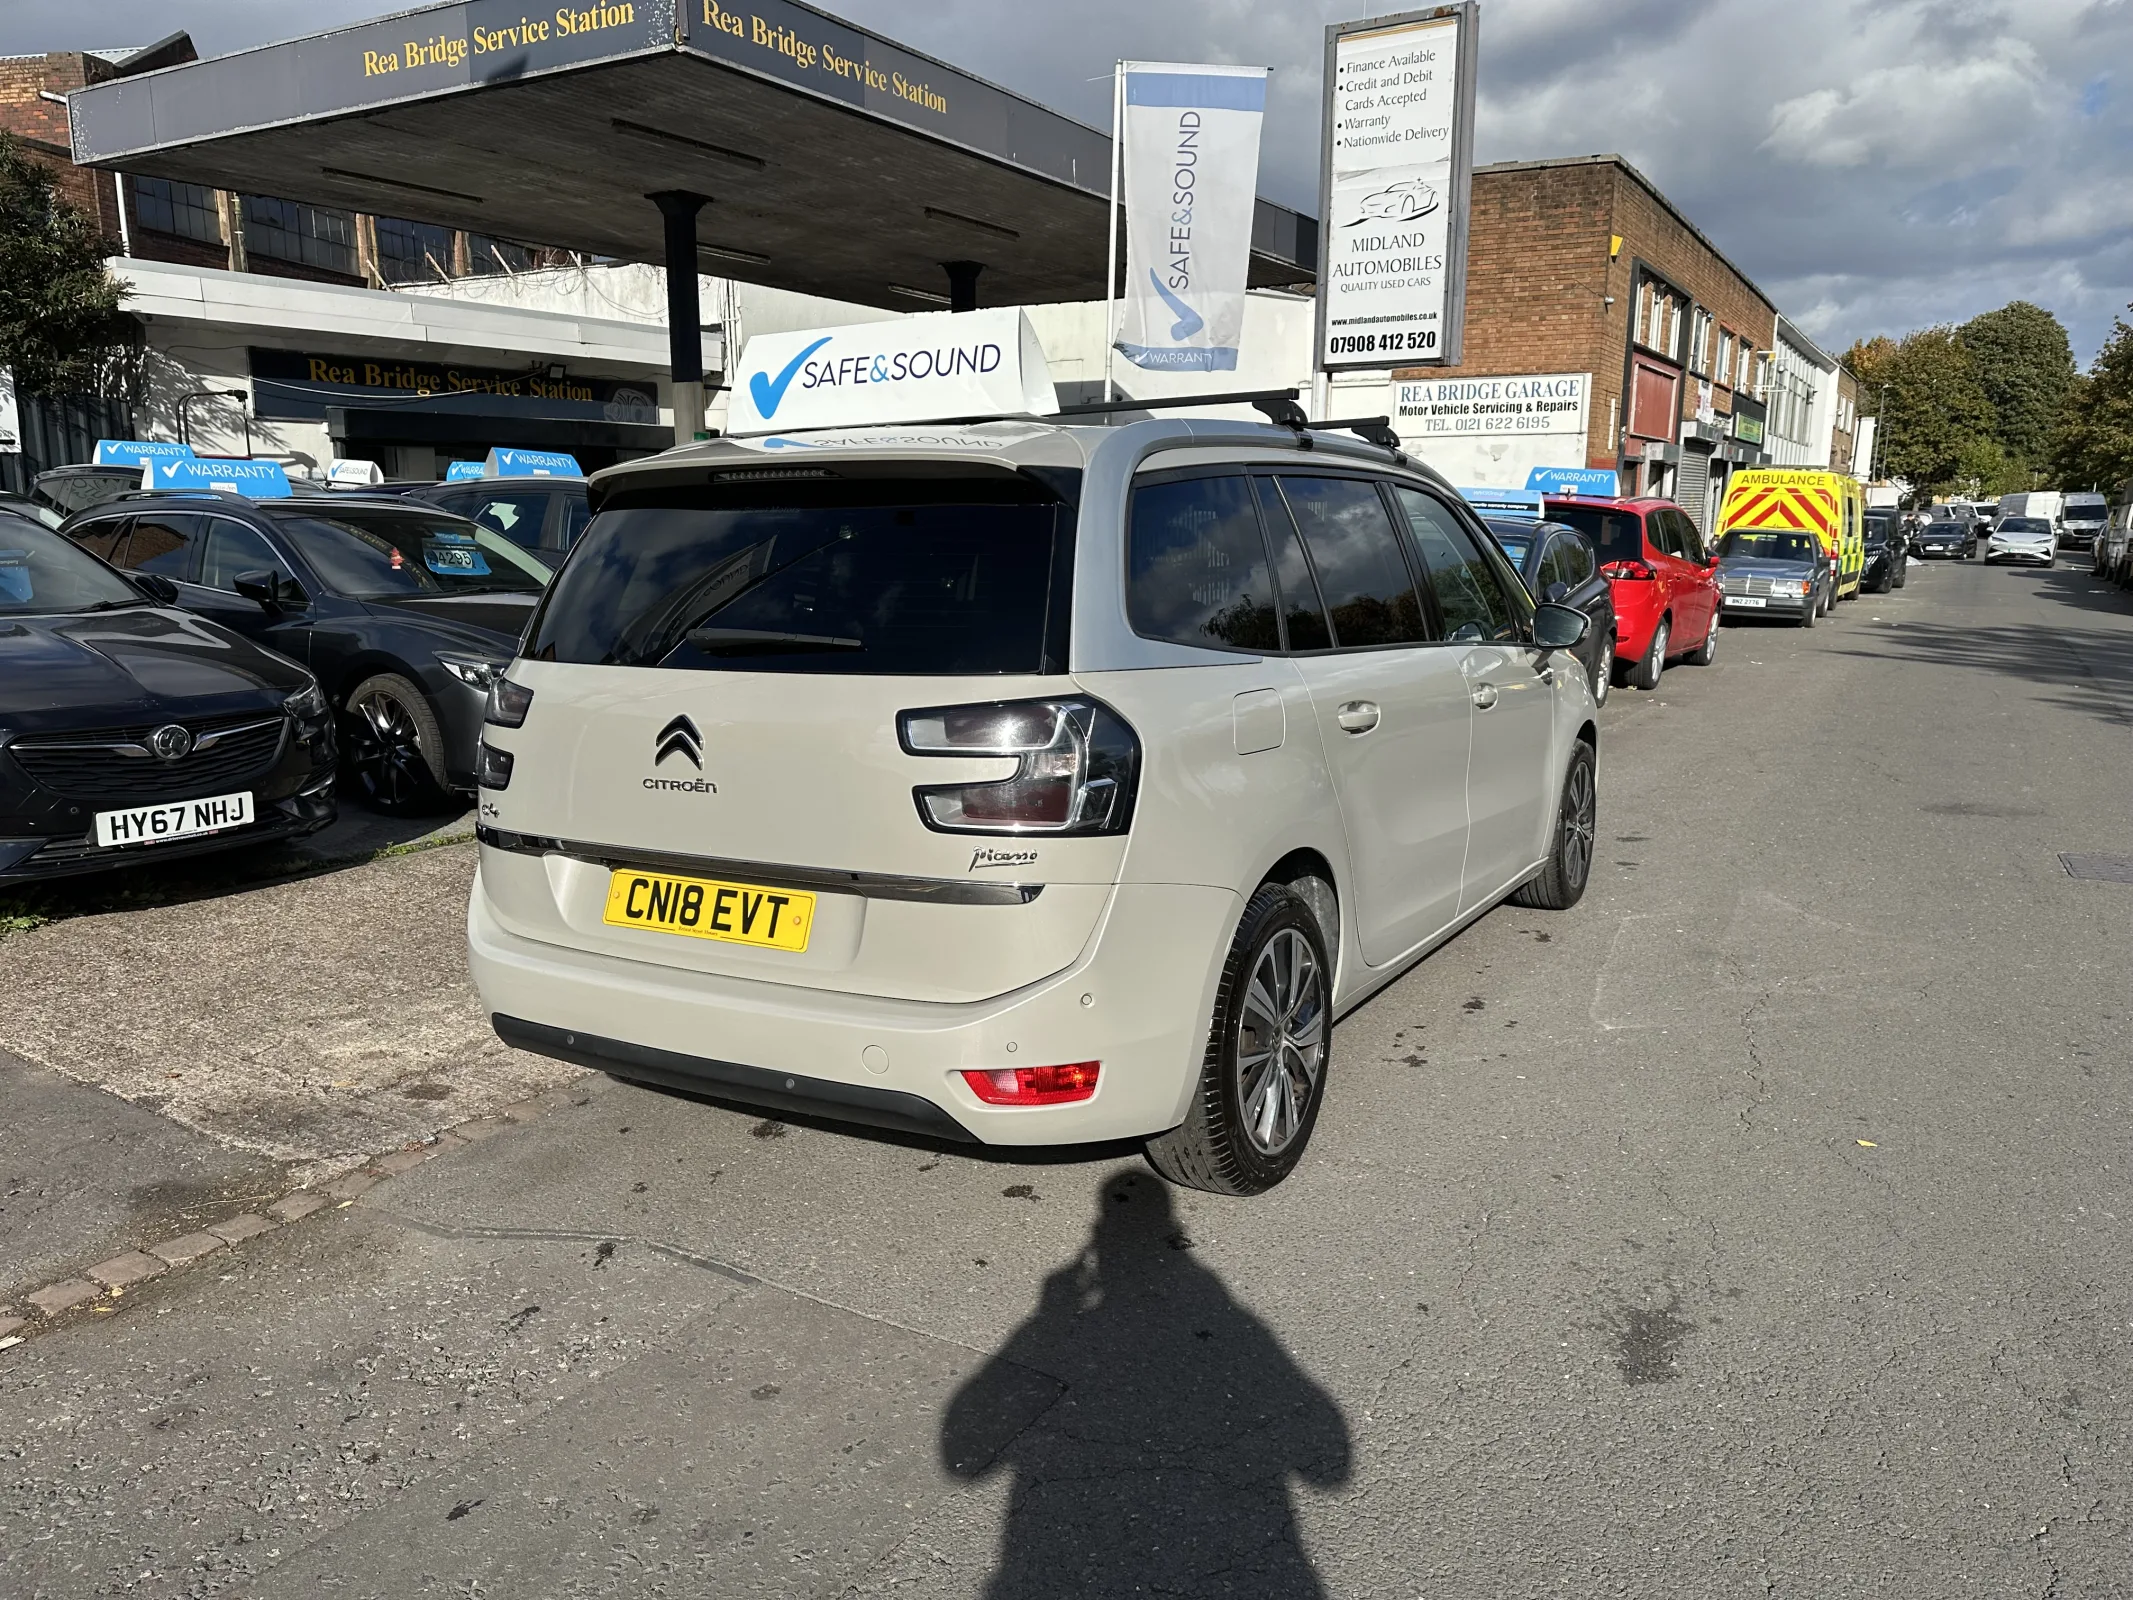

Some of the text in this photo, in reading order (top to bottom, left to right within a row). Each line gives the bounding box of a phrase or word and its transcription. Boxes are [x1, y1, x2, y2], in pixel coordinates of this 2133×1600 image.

[363, 1, 635, 77] Rea Bridge Service Station
[701, 0, 947, 114] Rea Bridge Service Station
[1346, 49, 1436, 74] Finance Available
[1345, 69, 1433, 92] Credit and Debit
[1345, 88, 1427, 111] Cards Accepted
[1344, 115, 1391, 130] Warranty
[1343, 126, 1450, 149] Nationwide Delivery
[1169, 111, 1201, 290] SAFE&SOUND
[1351, 232, 1425, 253] MIDLAND
[1332, 254, 1442, 278] AUTOMOBILES
[1340, 276, 1432, 293] QUALITY USED CARS
[1331, 311, 1438, 327] www.midlandautomobiles.co.uk
[1330, 330, 1437, 354] 07908 412 520
[802, 343, 1002, 389] SAFE&SOUND
[1149, 351, 1213, 364] WARRANTY
[308, 358, 594, 402] Rea Bridge Service Station
[1400, 379, 1580, 403] REA BRIDGE GARAGE
[1399, 400, 1578, 417] Motor Vehicle Servicing & Repairs
[1425, 416, 1551, 432] TEL. 0121 622 6195
[122, 444, 187, 457] WARRANTY
[514, 453, 573, 469] WARRANTY
[184, 463, 276, 479] WARRANTY
[1550, 471, 1610, 484] WARRANTY
[1741, 474, 1825, 486] AMBULANCE
[110, 797, 244, 840] HY67 NHJ
[625, 878, 789, 938] CN18 EVT
